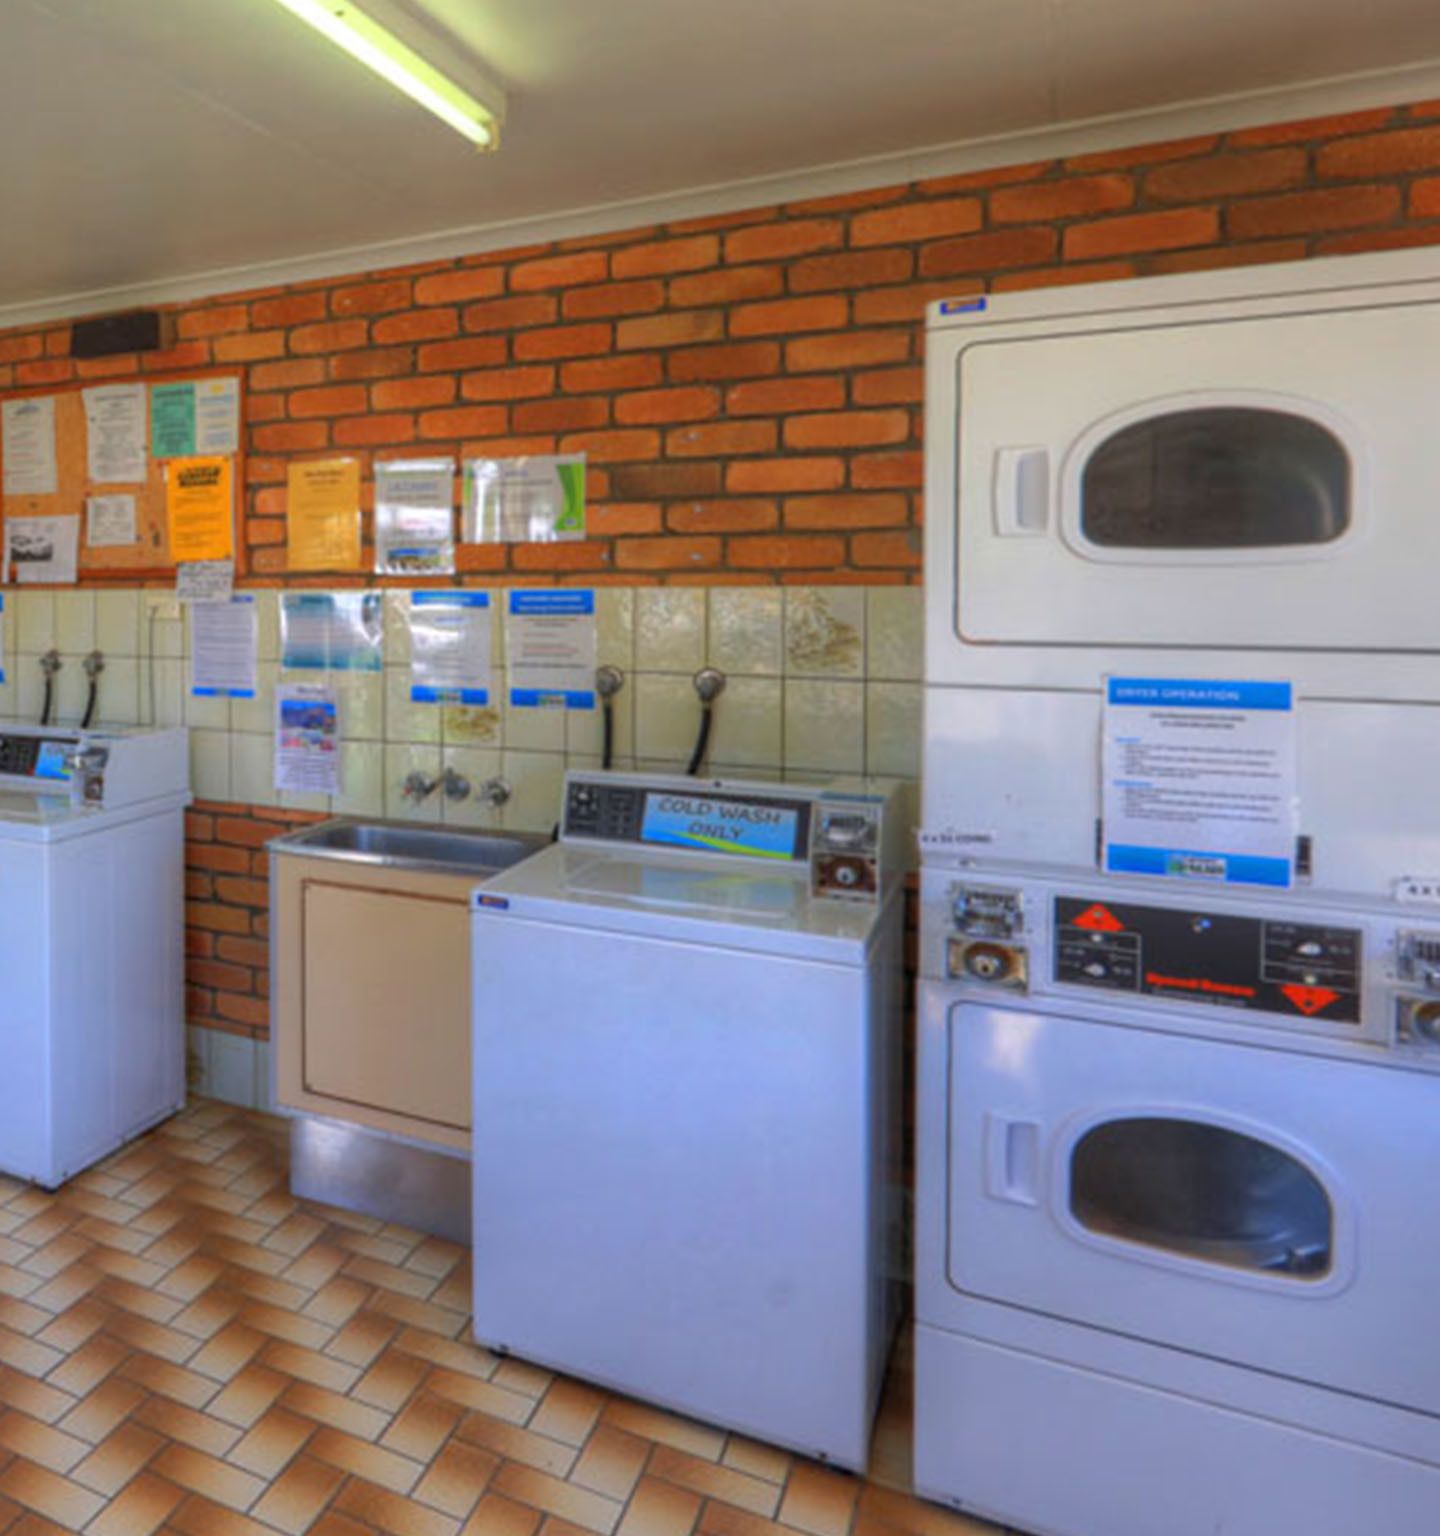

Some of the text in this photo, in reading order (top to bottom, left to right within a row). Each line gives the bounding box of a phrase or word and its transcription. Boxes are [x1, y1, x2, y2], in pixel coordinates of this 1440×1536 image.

[1161, 688, 1241, 701] OPERATION
[659, 797, 783, 826] COLD WASH
[688, 821, 745, 841] ONLY
